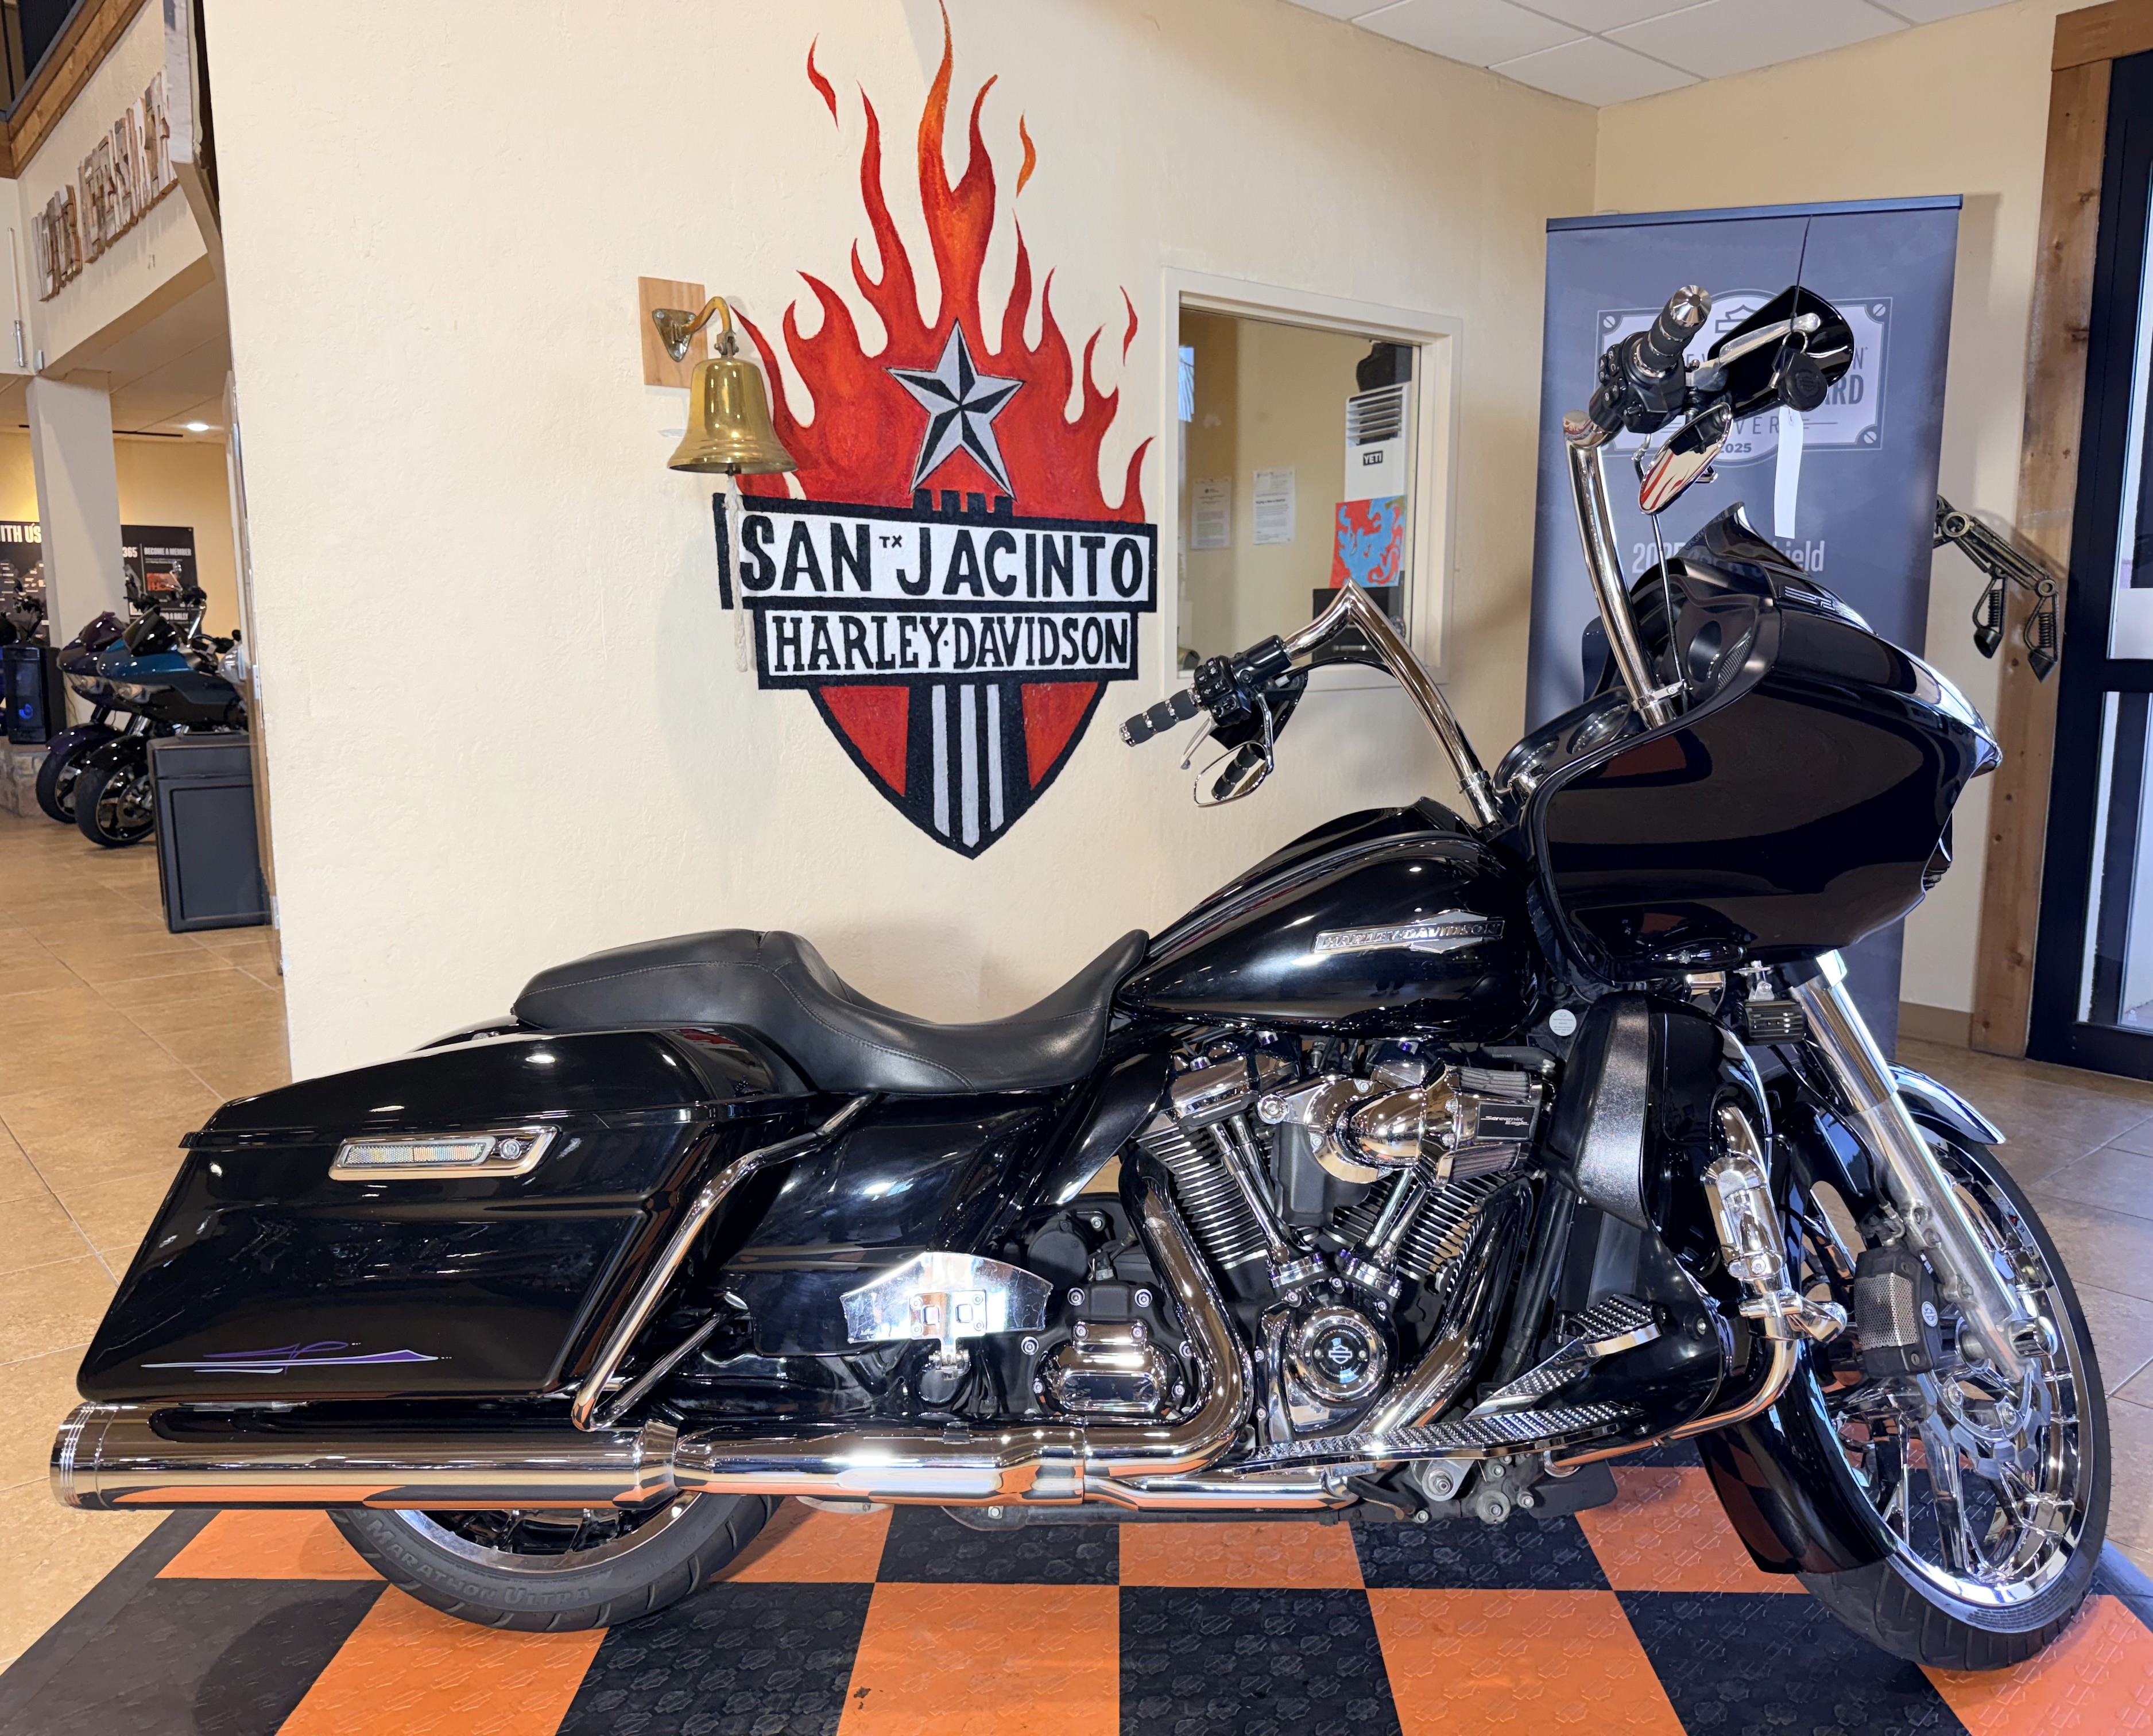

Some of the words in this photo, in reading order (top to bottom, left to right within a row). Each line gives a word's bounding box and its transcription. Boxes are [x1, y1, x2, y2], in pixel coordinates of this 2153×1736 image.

[1364, 452, 1382, 464] YETI
[0, 525, 23, 542] ITH
[740, 514, 872, 591] SAN
[879, 535, 902, 548] TX
[896, 527, 1143, 598] JACINTO
